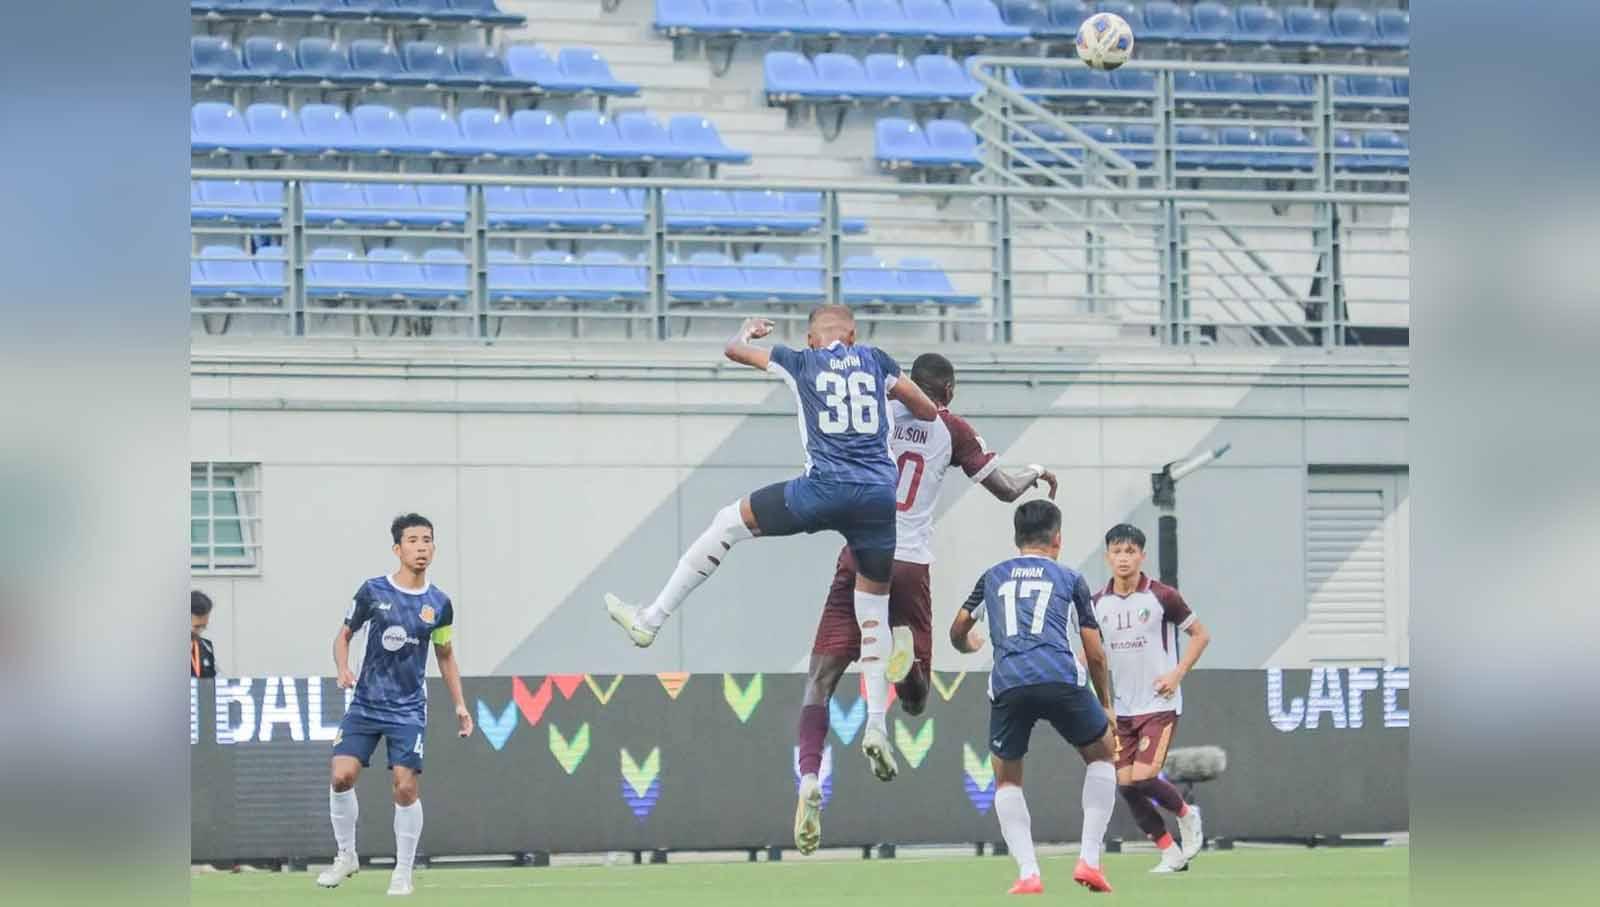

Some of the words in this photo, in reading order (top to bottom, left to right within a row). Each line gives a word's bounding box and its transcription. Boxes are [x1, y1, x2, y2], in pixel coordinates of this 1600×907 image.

[815, 371, 880, 434] 36
[894, 425, 928, 445] ILSON
[1011, 567, 1044, 578] IRWAN
[998, 580, 1054, 637] 17
[1116, 611, 1132, 630] 11
[413, 733, 424, 759] 4
